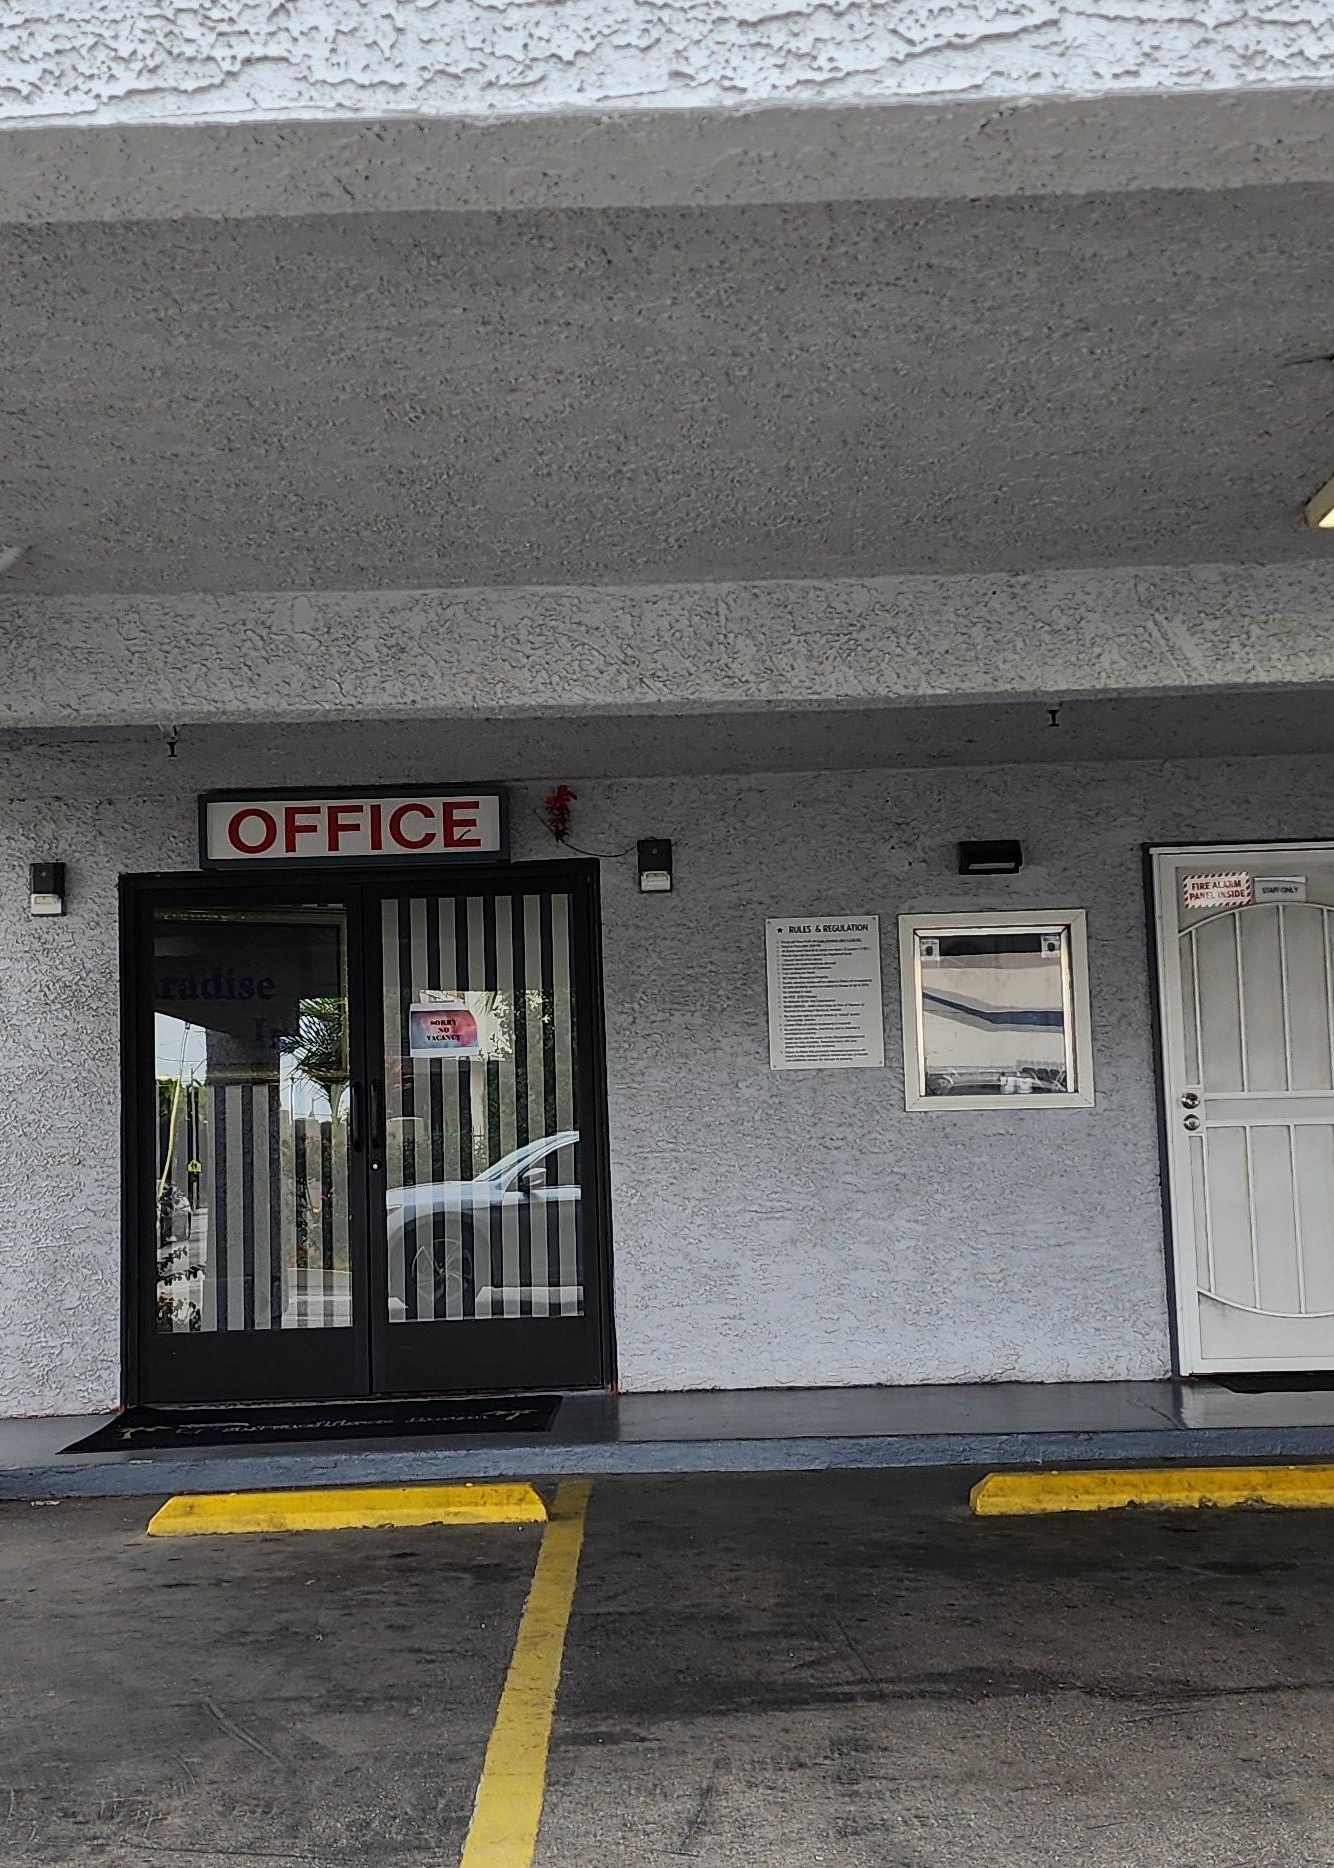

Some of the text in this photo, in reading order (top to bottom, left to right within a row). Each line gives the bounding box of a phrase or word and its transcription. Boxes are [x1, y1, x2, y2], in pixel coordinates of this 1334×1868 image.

[228, 801, 481, 854] OFFICE
[1192, 880, 1241, 890] FIRE ALARM
[1189, 889, 1245, 900] PANEL INSIDE
[788, 925, 811, 934] RULES
[823, 923, 868, 932] REGULATION
[155, 967, 275, 1000] radise
